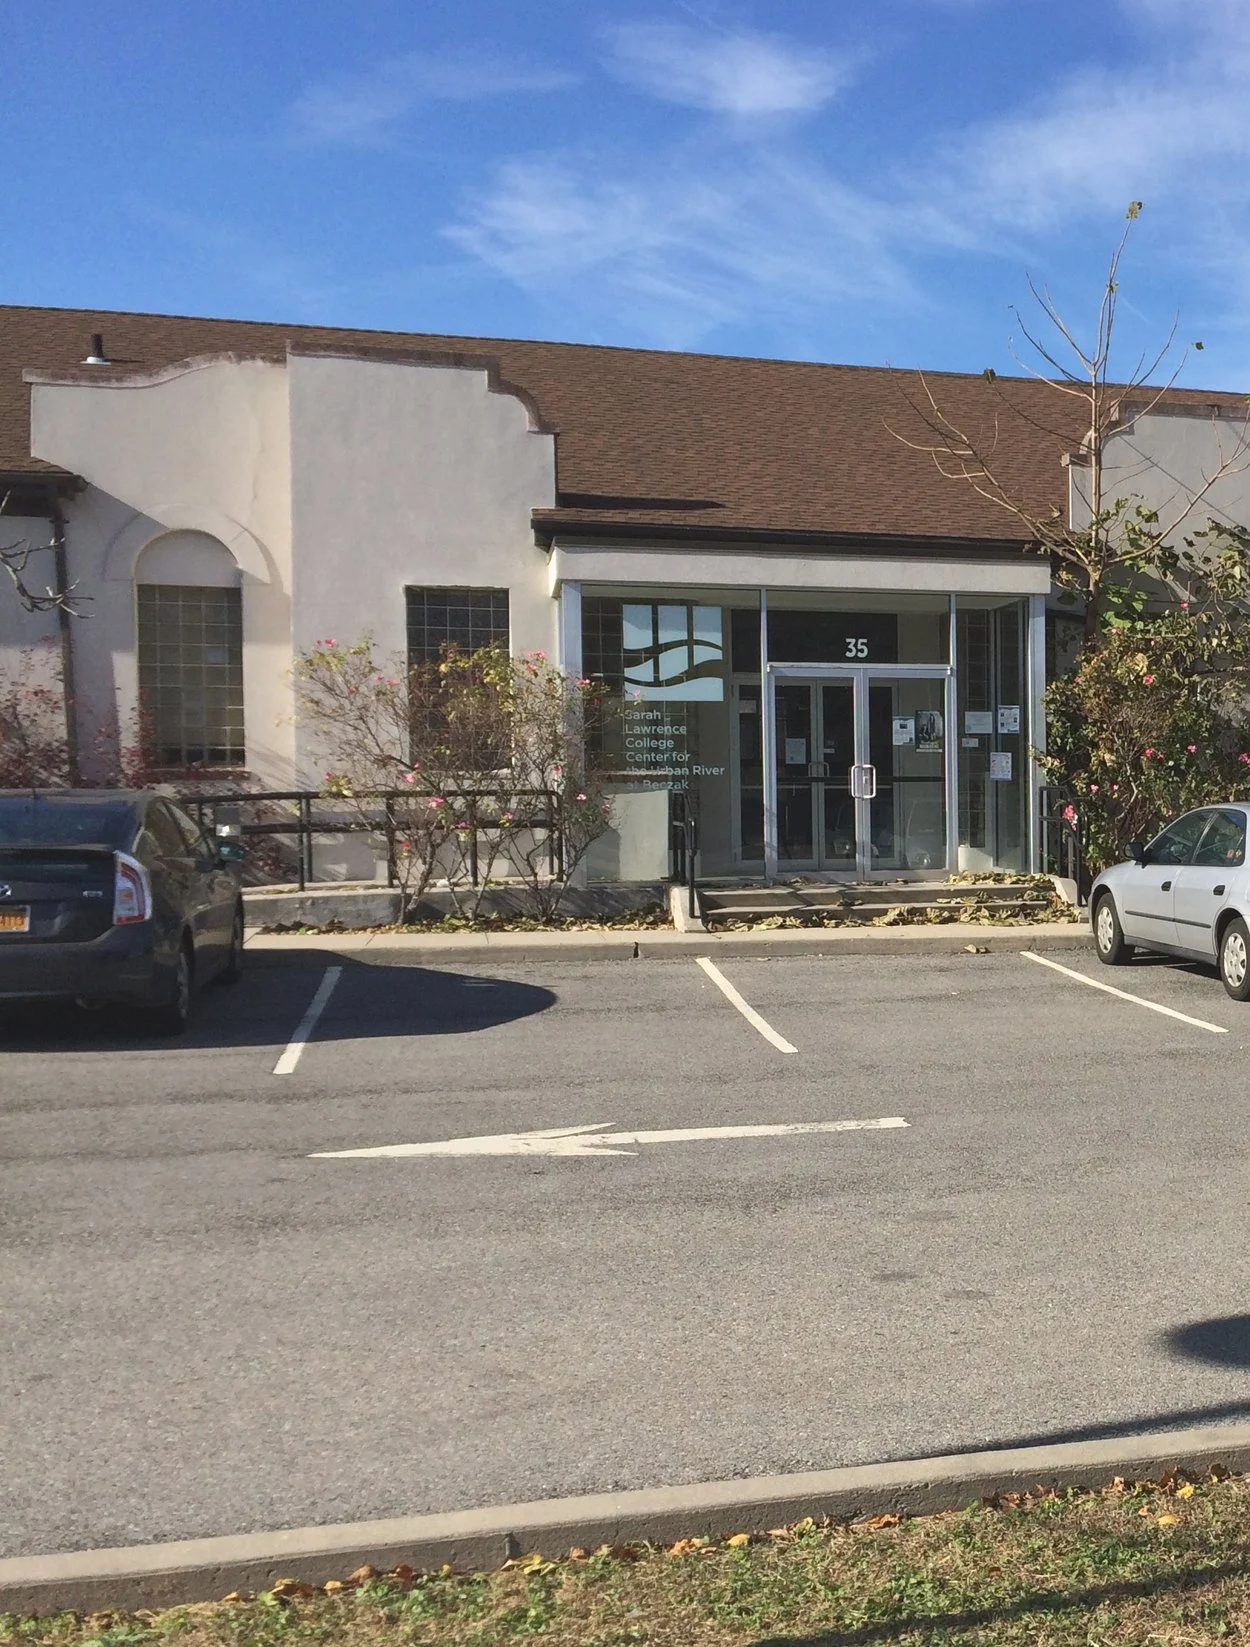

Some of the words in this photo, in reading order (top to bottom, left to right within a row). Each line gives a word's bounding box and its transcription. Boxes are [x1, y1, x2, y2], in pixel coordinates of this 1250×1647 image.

[845, 638, 869, 658] 35
[624, 709, 661, 720] Sarah
[625, 723, 687, 734] Lawrence
[625, 737, 674, 749] College
[625, 751, 669, 762] Center
[672, 751, 691, 762] for
[692, 765, 725, 776] River
[642, 779, 689, 790] Beczak
